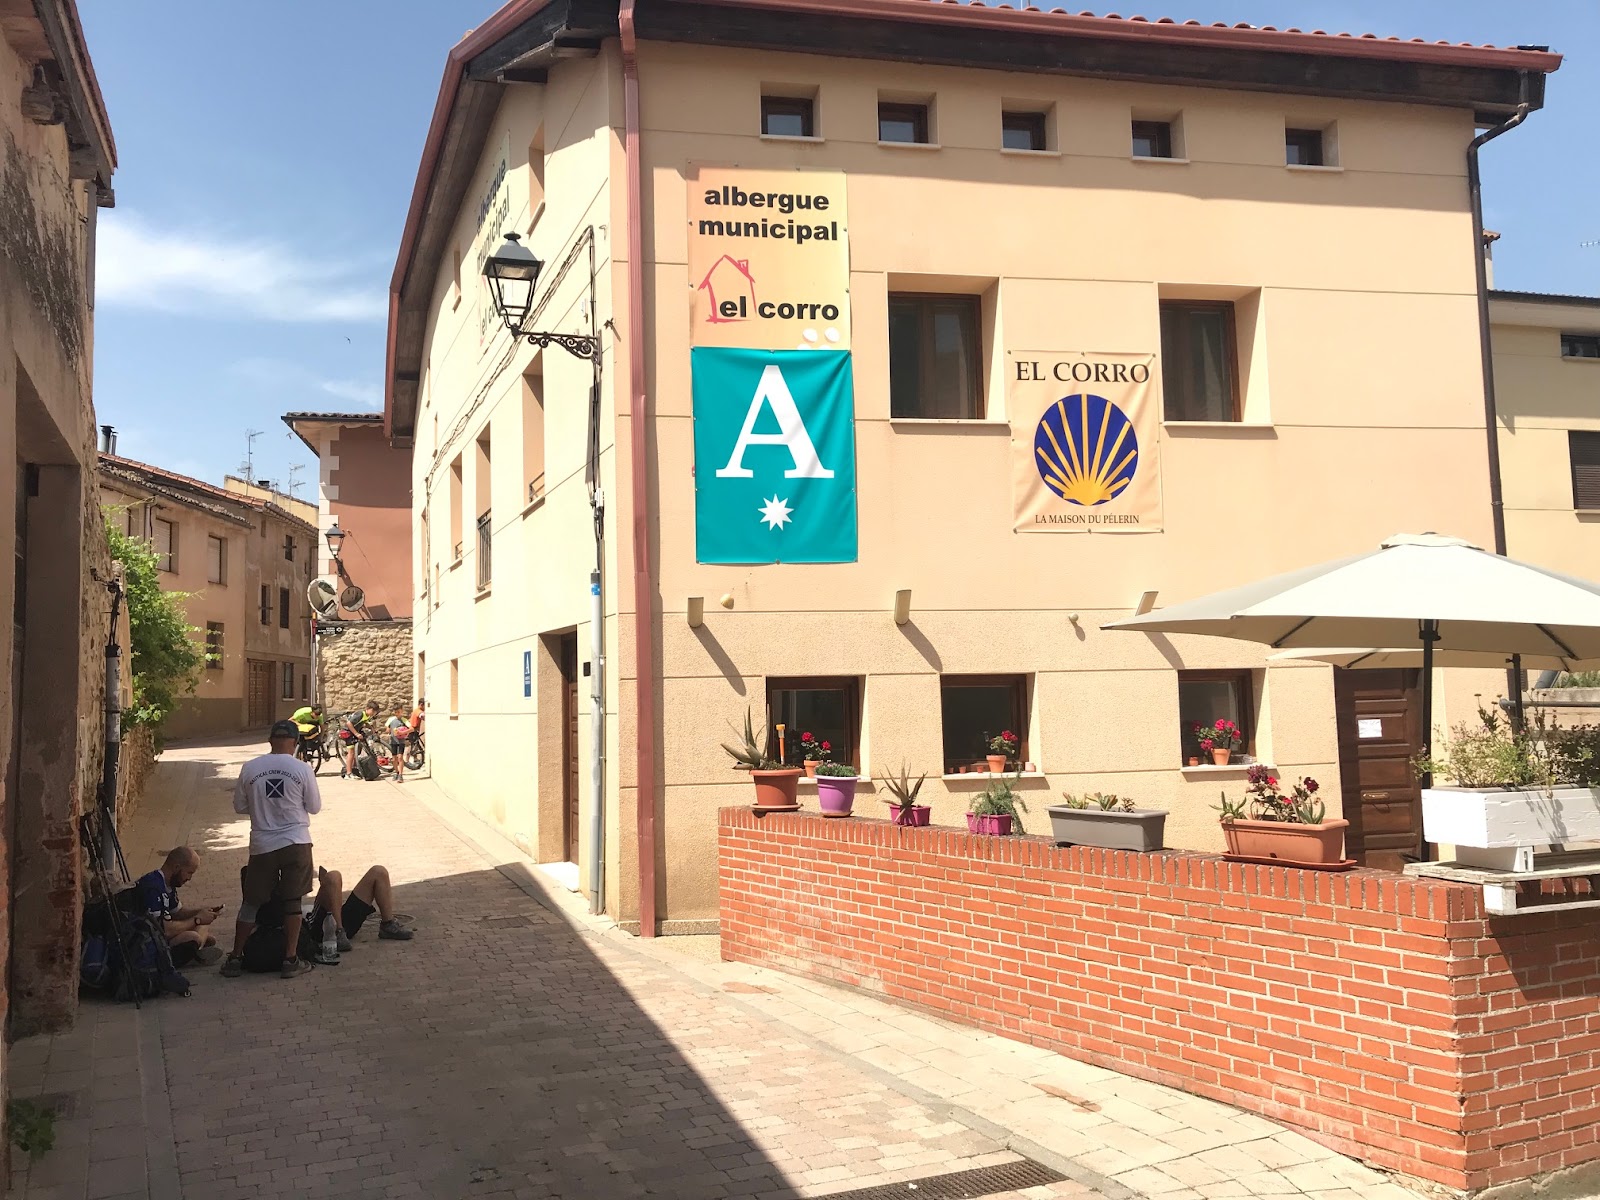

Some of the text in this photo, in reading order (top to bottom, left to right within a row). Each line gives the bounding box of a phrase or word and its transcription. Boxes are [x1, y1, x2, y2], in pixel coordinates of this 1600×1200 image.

[704, 185, 830, 214] albergue
[699, 218, 838, 245] municipal
[719, 296, 839, 321] el corro
[1015, 361, 1150, 383] EL CORRO
[715, 364, 835, 479] A
[1035, 512, 1140, 524] LA MAISON DU PÉLERIN
